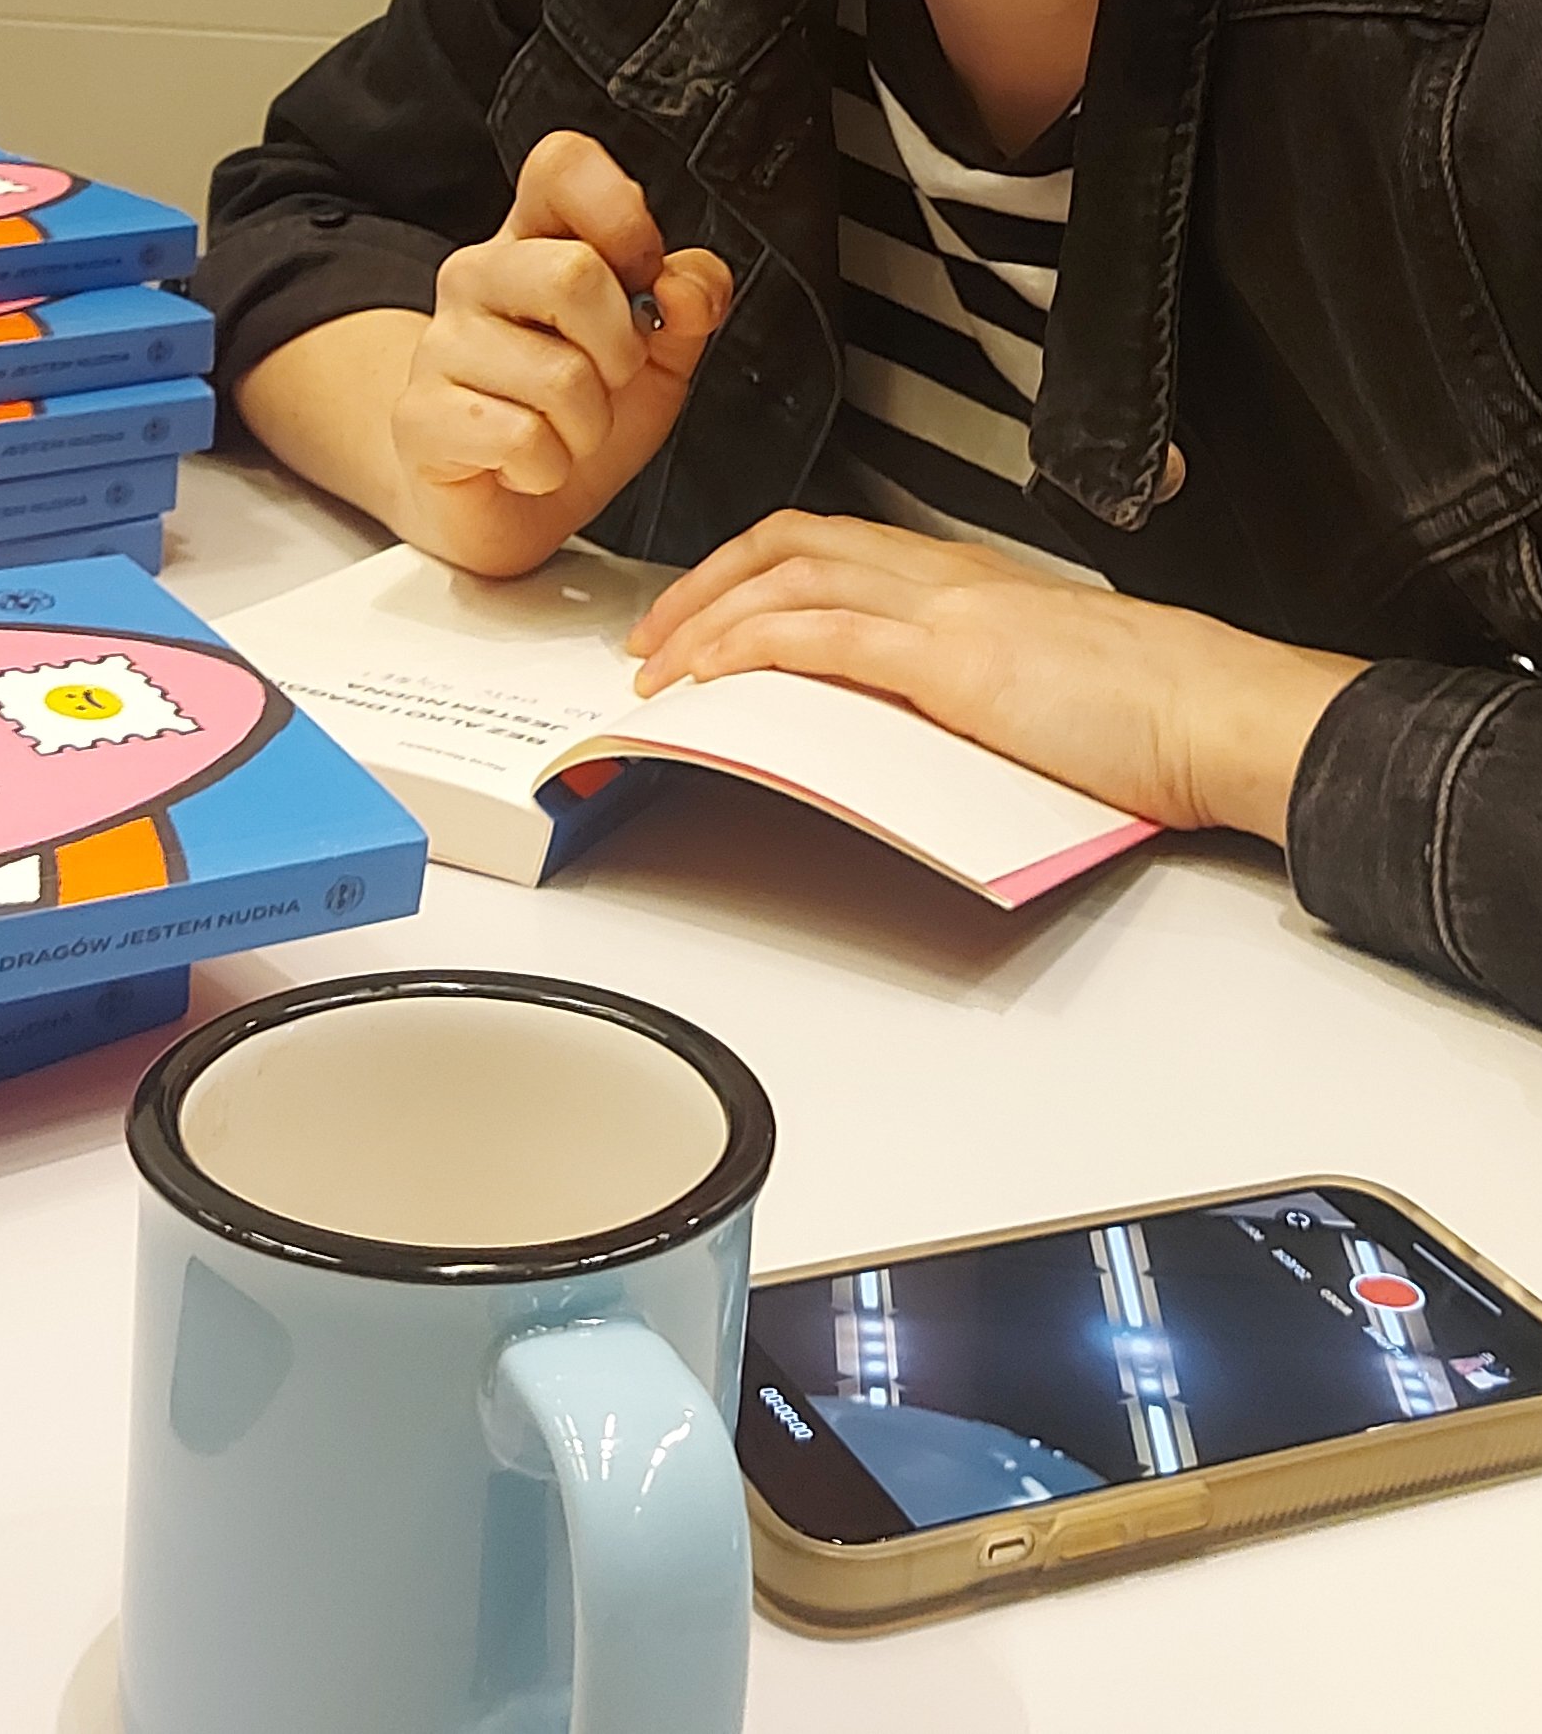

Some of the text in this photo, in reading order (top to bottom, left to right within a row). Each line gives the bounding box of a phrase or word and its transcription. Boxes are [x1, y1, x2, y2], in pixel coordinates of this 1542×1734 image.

[347, 681, 448, 707] NUDNA
[449, 701, 569, 732] JESTEM
[485, 725, 549, 746] BEZ
[115, 915, 214, 950] JESTEM
[216, 899, 300, 928] NUDNA
[759, 1387, 814, 1442] 00:00:00
